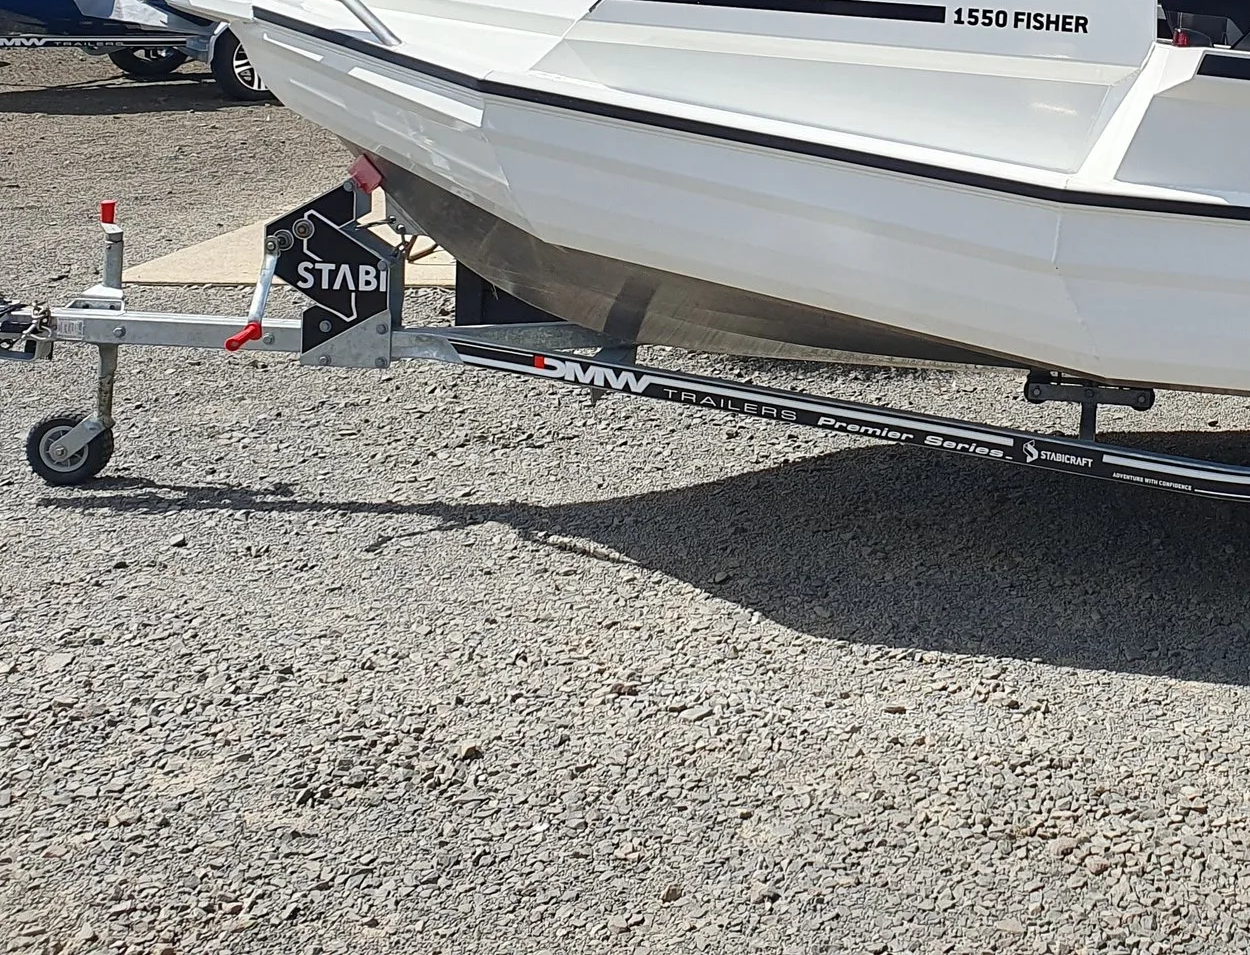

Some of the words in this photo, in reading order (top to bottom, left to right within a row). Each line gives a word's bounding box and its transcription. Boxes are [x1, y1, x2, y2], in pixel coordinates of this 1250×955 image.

[953, 7, 1008, 28] 1550
[1013, 11, 1089, 34] FISHER
[296, 261, 387, 293] STABI
[533, 354, 652, 394] DMW
[663, 387, 798, 422] TRAILERS
[817, 416, 914, 442] Premier
[1040, 450, 1094, 468] STABICRAFT
[1112, 472, 1143, 483] ADVENTURE
[1159, 480, 1192, 491] CONFIDENCE
